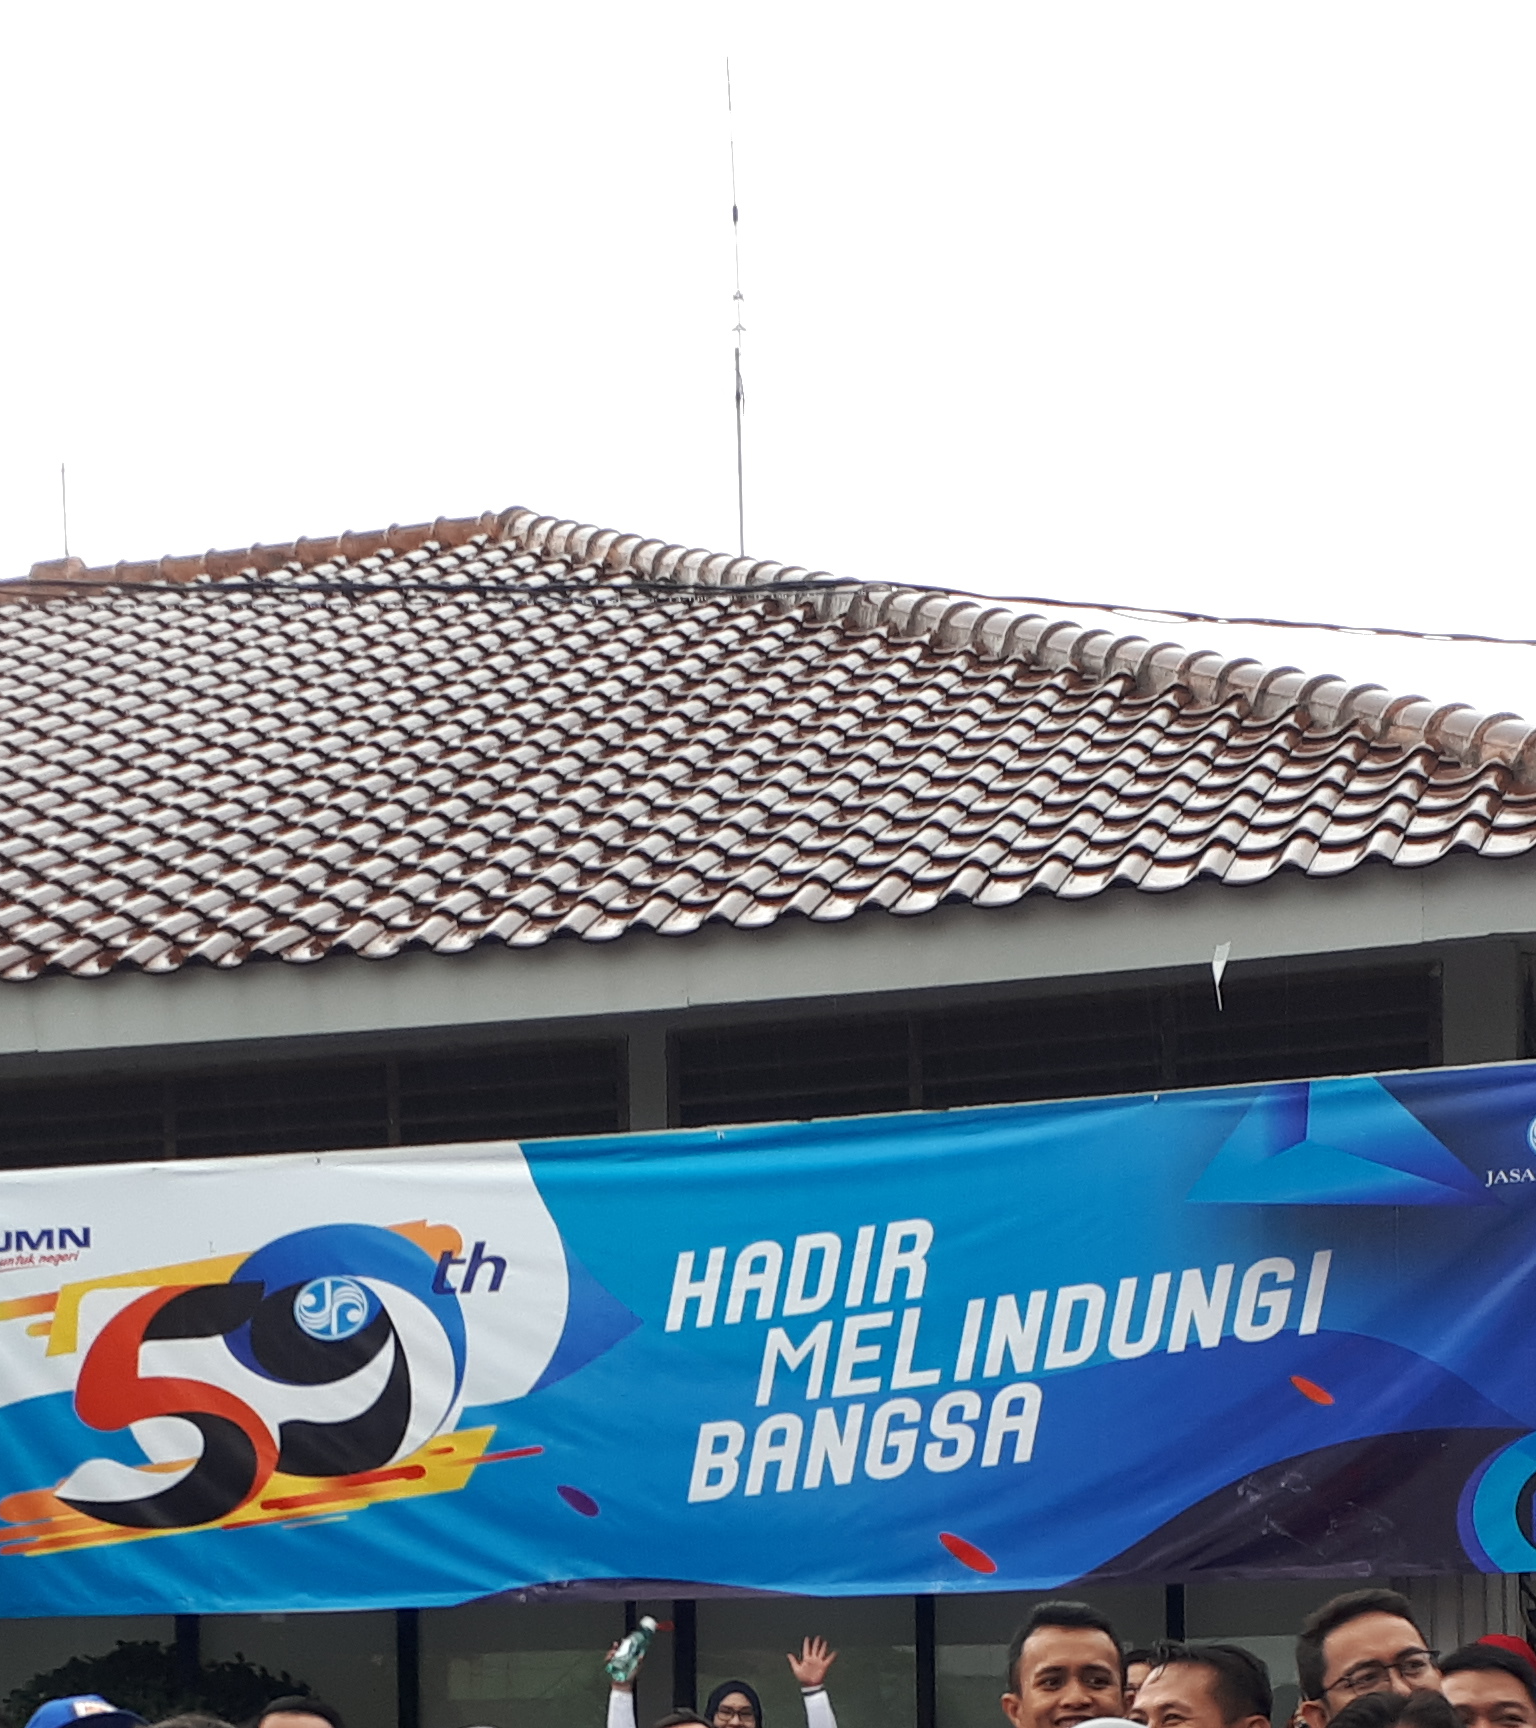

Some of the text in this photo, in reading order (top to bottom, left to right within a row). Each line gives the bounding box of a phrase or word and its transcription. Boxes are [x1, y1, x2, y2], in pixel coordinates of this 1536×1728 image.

[1485, 1168, 1536, 1188] JASA
[0, 1253, 35, 1266] untuk
[664, 1219, 934, 1332] HADIR
[688, 1383, 1043, 1503] BANGSA
